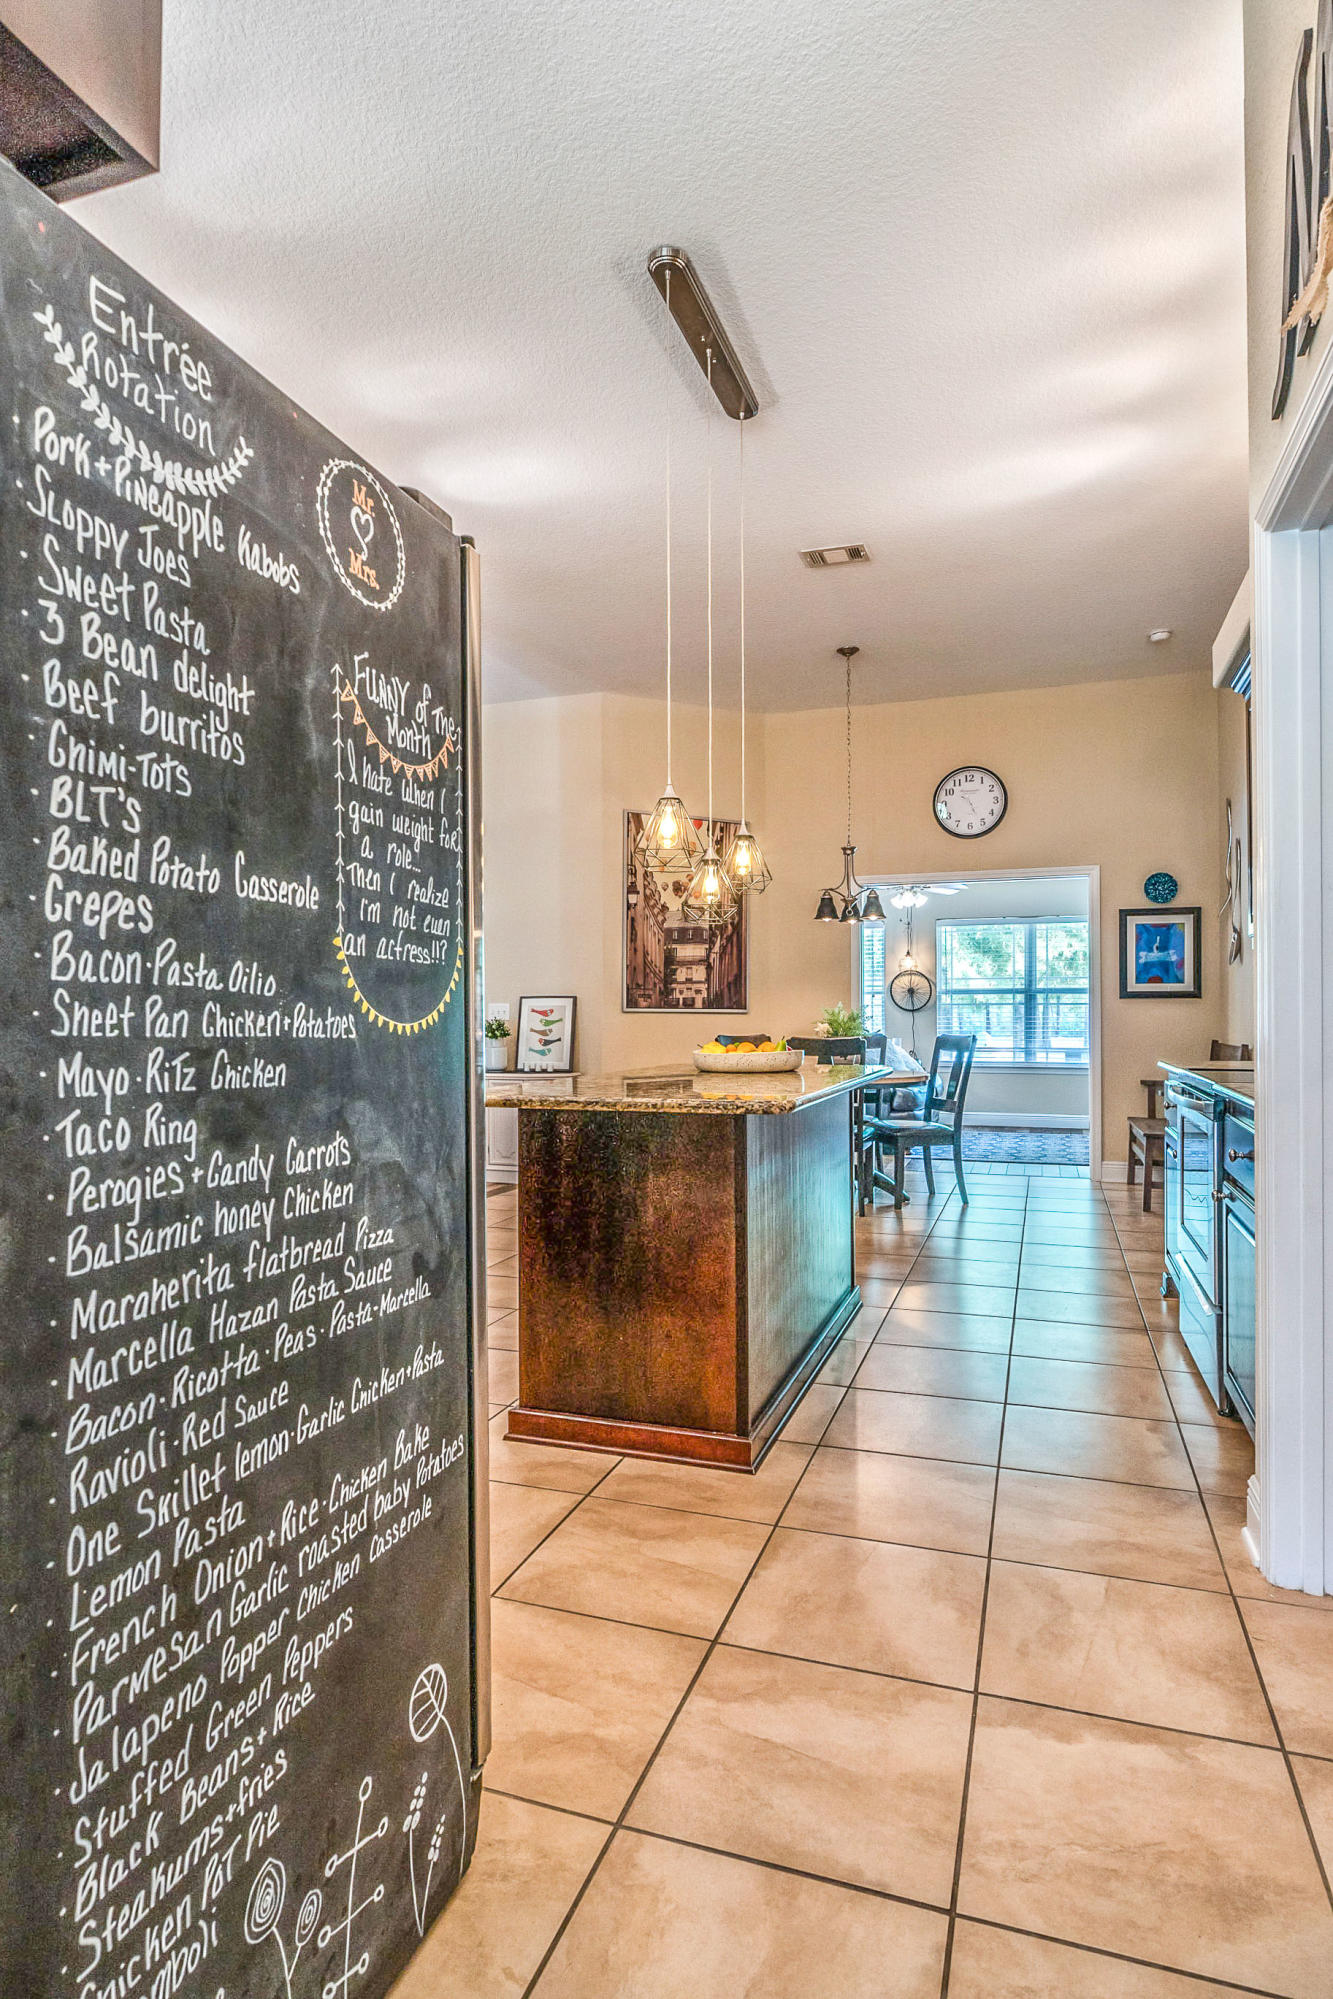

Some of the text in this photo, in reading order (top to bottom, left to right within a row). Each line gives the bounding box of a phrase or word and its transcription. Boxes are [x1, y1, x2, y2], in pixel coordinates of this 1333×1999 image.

[81, 331, 216, 457] Rotation
[352, 479, 376, 518] Mr.
[138, 524, 191, 588] Joes
[237, 524, 300, 595] Kabobs
[348, 547, 380, 590] Mrs.
[38, 533, 211, 656] Sweet Pasta
[38, 598, 255, 733] 3 Bean delight
[43, 658, 246, 766] Beef burritos
[415, 683, 432, 727] of
[386, 713, 432, 760] Month
[362, 756, 393, 796] hate
[944, 788, 955, 797] 10
[953, 779, 962, 787] 11
[964, 774, 975, 783] 12
[988, 784, 995, 793] 2
[993, 796, 999, 805] 3
[349, 800, 384, 835] gain
[392, 813, 434, 853] weight
[954, 820, 961, 828] 7
[967, 822, 974, 830] 6
[980, 818, 986, 826] 5
[988, 808, 994, 816] 4
[149, 835, 221, 894] Potato
[234, 850, 320, 910] Casserole
[346, 861, 381, 893] Then
[407, 876, 450, 909] realize
[43, 872, 154, 940] Crepes
[344, 933, 367, 957] an
[145, 994, 189, 1039] Pan
[210, 1048, 287, 1091] Chicken
[54, 1101, 198, 1162] Taco Ring
[65, 1161, 185, 1228] Perogies
[206, 1143, 274, 1194] Candy
[285, 1130, 351, 1177] Carrots
[65, 1178, 354, 1277] Balsamic honey Chicken
[242, 1221, 346, 1283] flatbread
[355, 1215, 395, 1252] Pizza
[67, 1255, 393, 1401] Marcella Hazan Pasta Sauce
[182, 1396, 226, 1457] Red
[234, 1379, 289, 1429] Sauce
[66, 1521, 122, 1577] One
[136, 1452, 227, 1539] Skillet
[229, 1561, 290, 1628] Garlic
[298, 1494, 369, 1578] roasted
[373, 1478, 411, 1521] baby
[416, 1434, 465, 1490] Potatoes
[69, 1494, 247, 1632] Lemon Pasta
[71, 1583, 177, 1687] French
[194, 1535, 264, 1605] Onion
[69, 1675, 208, 1805] Jalapeno
[220, 1607, 290, 1684] Popper
[73, 1606, 353, 1869] Stuffed Green Peppers
[179, 1735, 255, 1825] Beans
[272, 1681, 316, 1737] Rice
[245, 1804, 281, 1862] Pie
